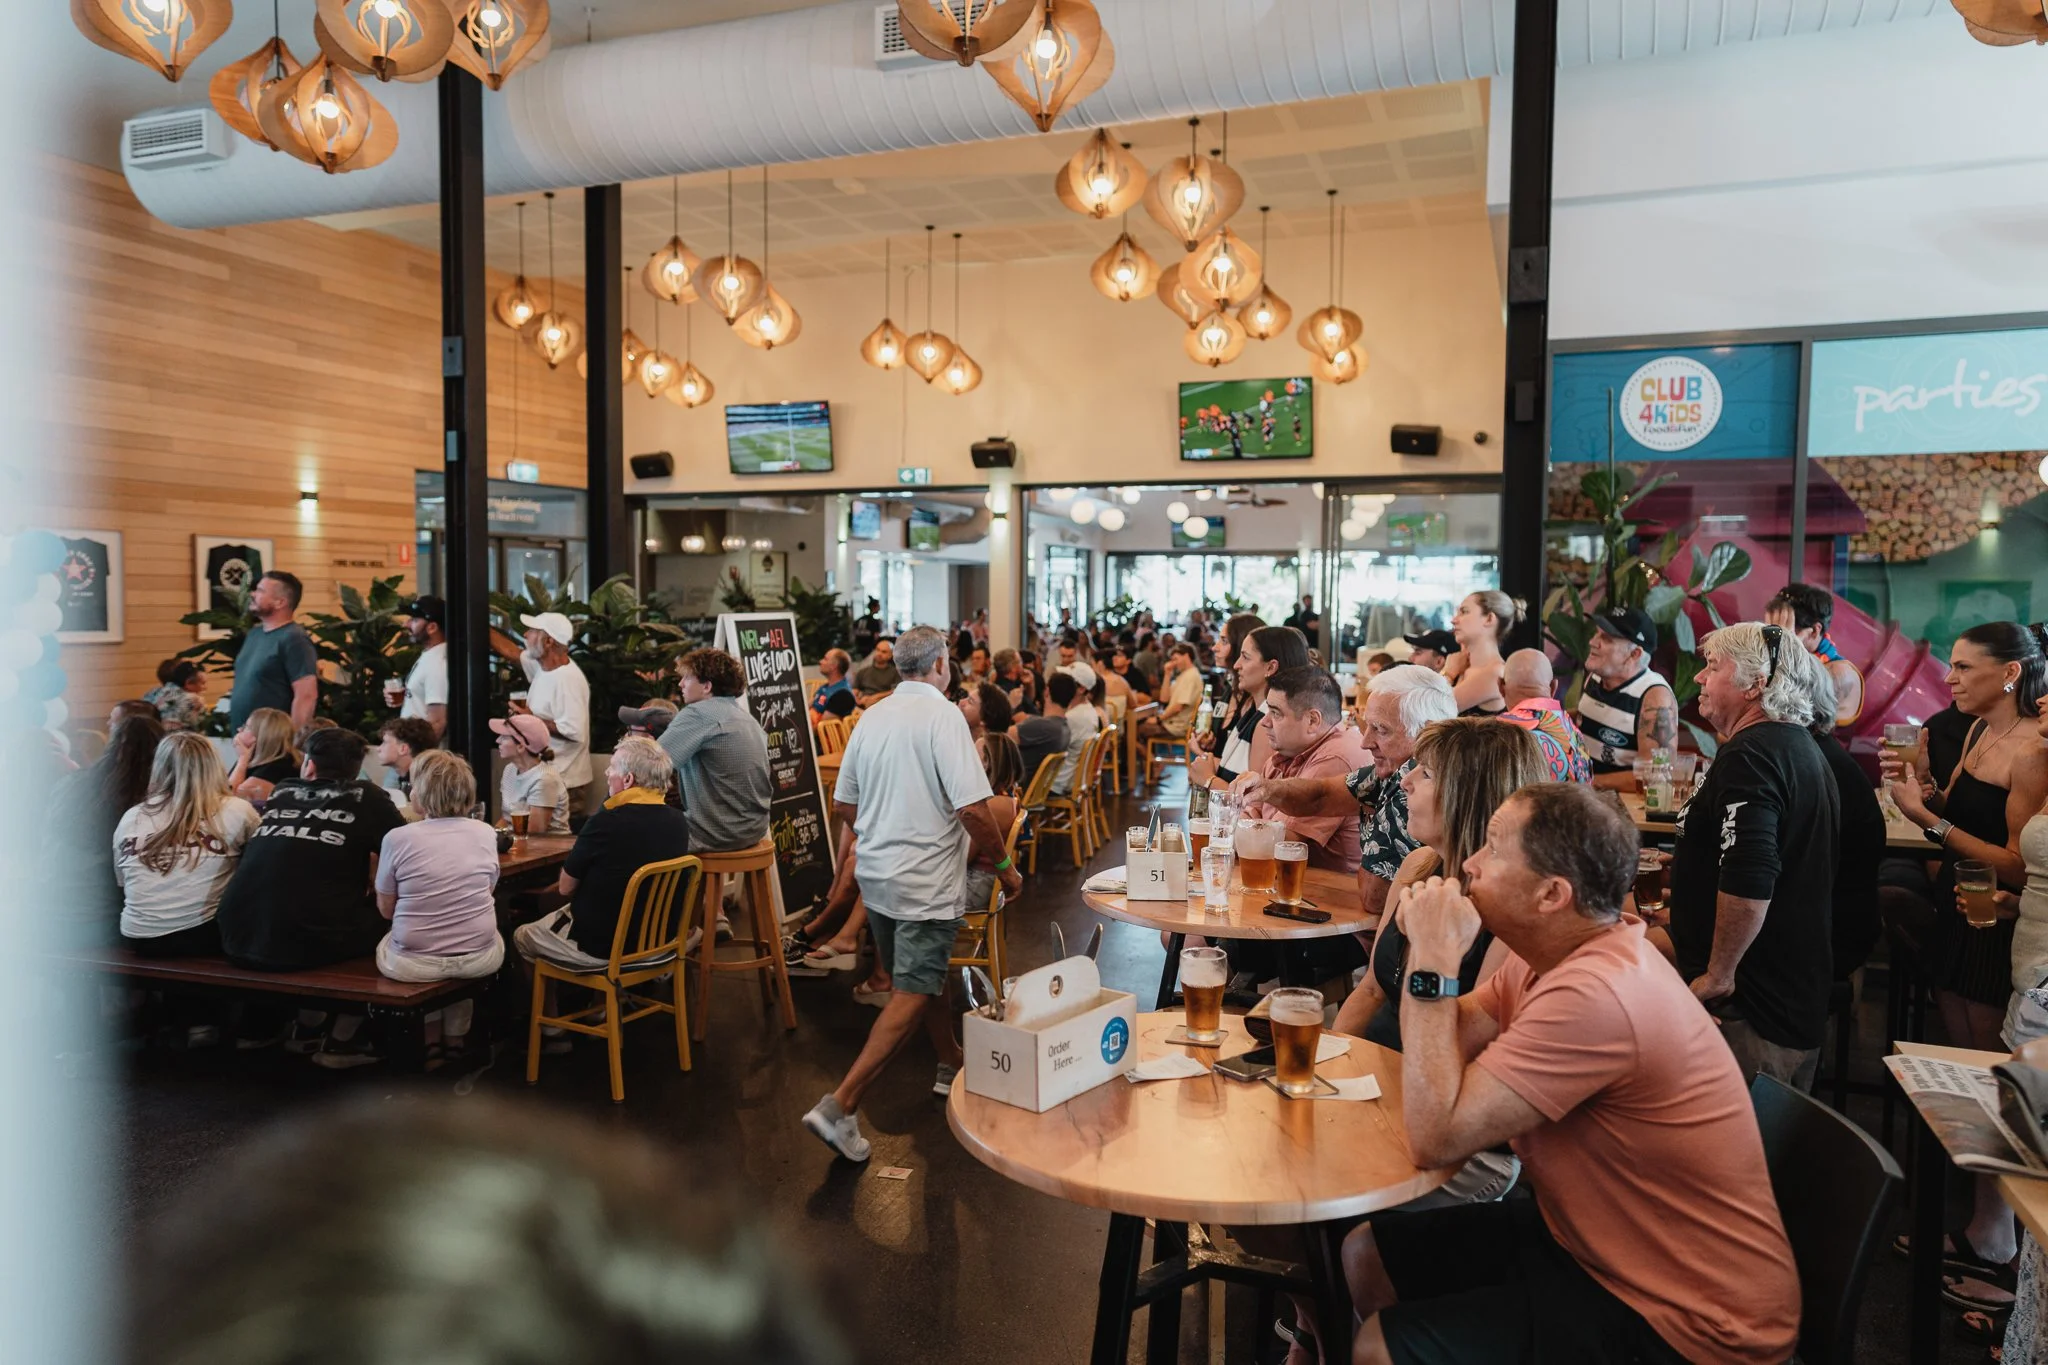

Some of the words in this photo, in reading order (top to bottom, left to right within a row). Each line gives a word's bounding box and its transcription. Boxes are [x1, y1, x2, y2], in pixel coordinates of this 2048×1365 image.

[1640, 376, 1702, 401] CLUB
[1853, 358, 2048, 433] parties
[740, 629, 762, 650] NRL
[769, 629, 789, 649] AFL
[744, 651, 768, 686] LIVE
[770, 649, 796, 681] LOUD
[304, 808, 356, 824] NO
[1150, 869, 1166, 882] 51
[1047, 1039, 1071, 1058] Order
[990, 1049, 1012, 1073] 50
[1053, 1055, 1074, 1072] Here
